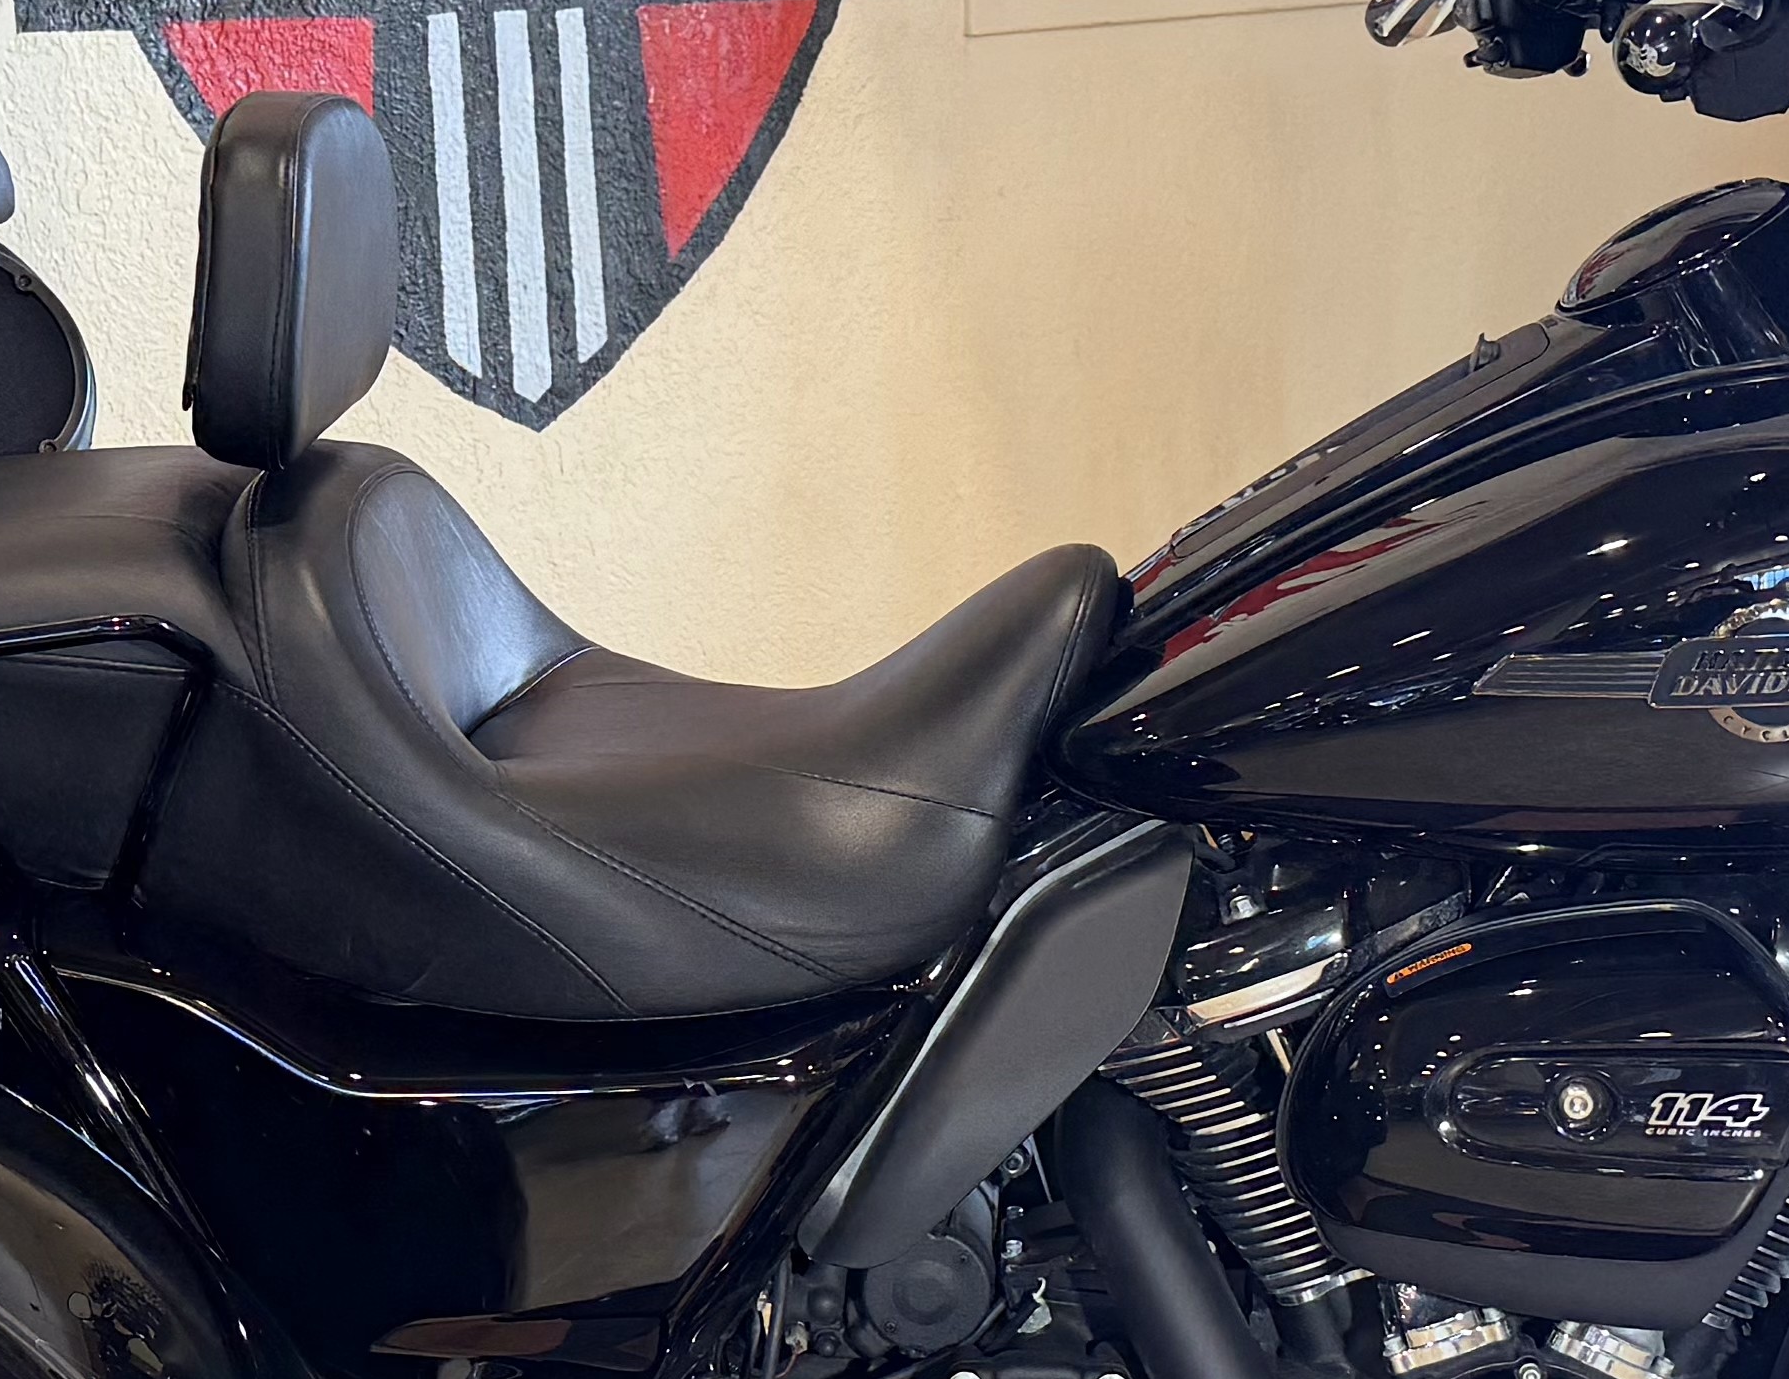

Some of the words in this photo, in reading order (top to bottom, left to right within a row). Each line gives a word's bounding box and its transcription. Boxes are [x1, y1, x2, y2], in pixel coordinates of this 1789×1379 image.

[1647, 1092, 1770, 1127] 114
[1644, 1127, 1696, 1137] CUBIC
[1702, 1128, 1762, 1138] INCHES
